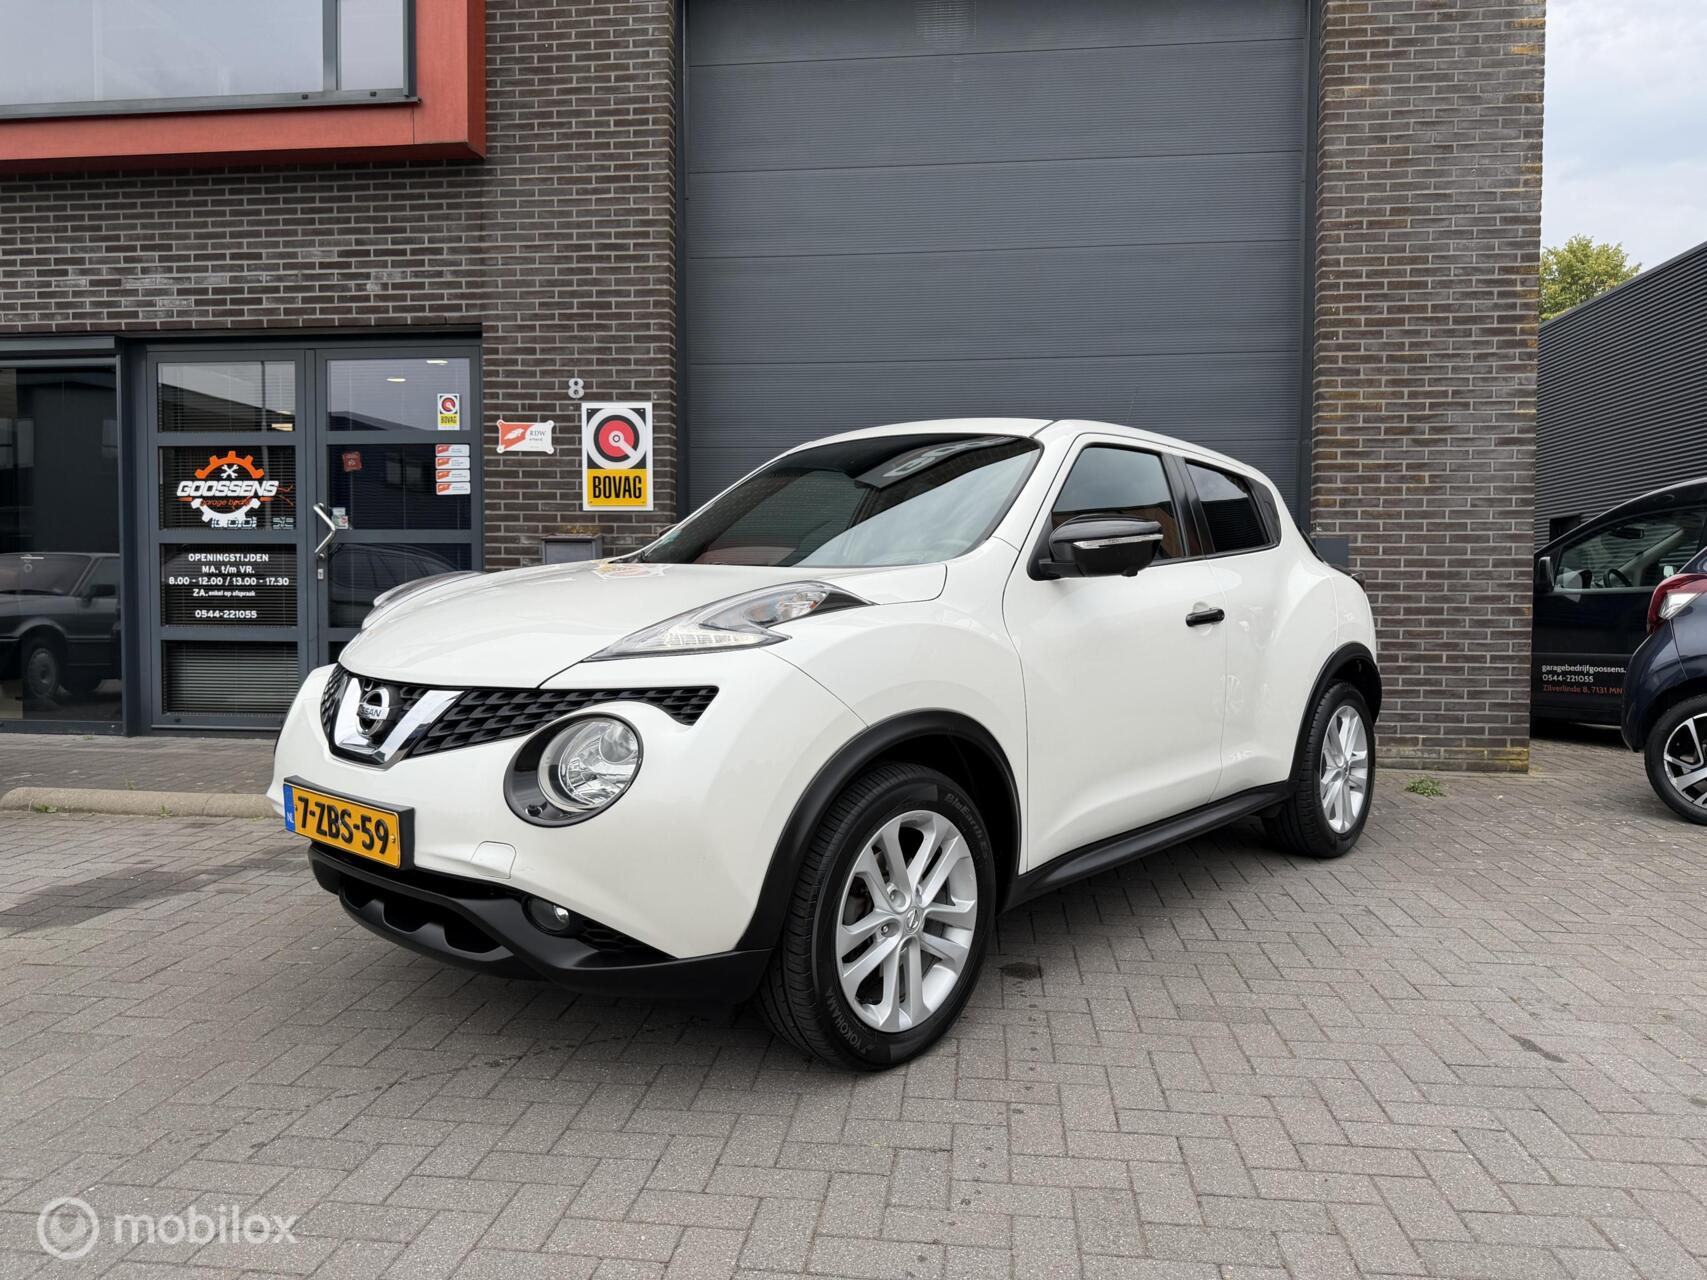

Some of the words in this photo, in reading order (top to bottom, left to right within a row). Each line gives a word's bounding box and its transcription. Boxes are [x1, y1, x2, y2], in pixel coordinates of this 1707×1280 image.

[568, 377, 584, 399] 8
[176, 480, 280, 497] GOOSSENS
[592, 475, 642, 499] BOVAG
[188, 553, 269, 562] OPENINGSTIJDEN
[201, 565, 219, 574] MA.
[221, 564, 237, 574] t/m
[239, 565, 255, 574] VR.
[168, 577, 190, 585] 8.00
[198, 577, 223, 586] 12.00
[232, 577, 257, 586] 13.00
[265, 577, 290, 586] 17.30
[194, 609, 258, 619] 0544-221055
[1542, 674, 1594, 683] 0544-221055
[1591, 686, 1608, 695] 7131
[286, 811, 295, 824] NL
[297, 795, 390, 855] 7-ZBS-59
